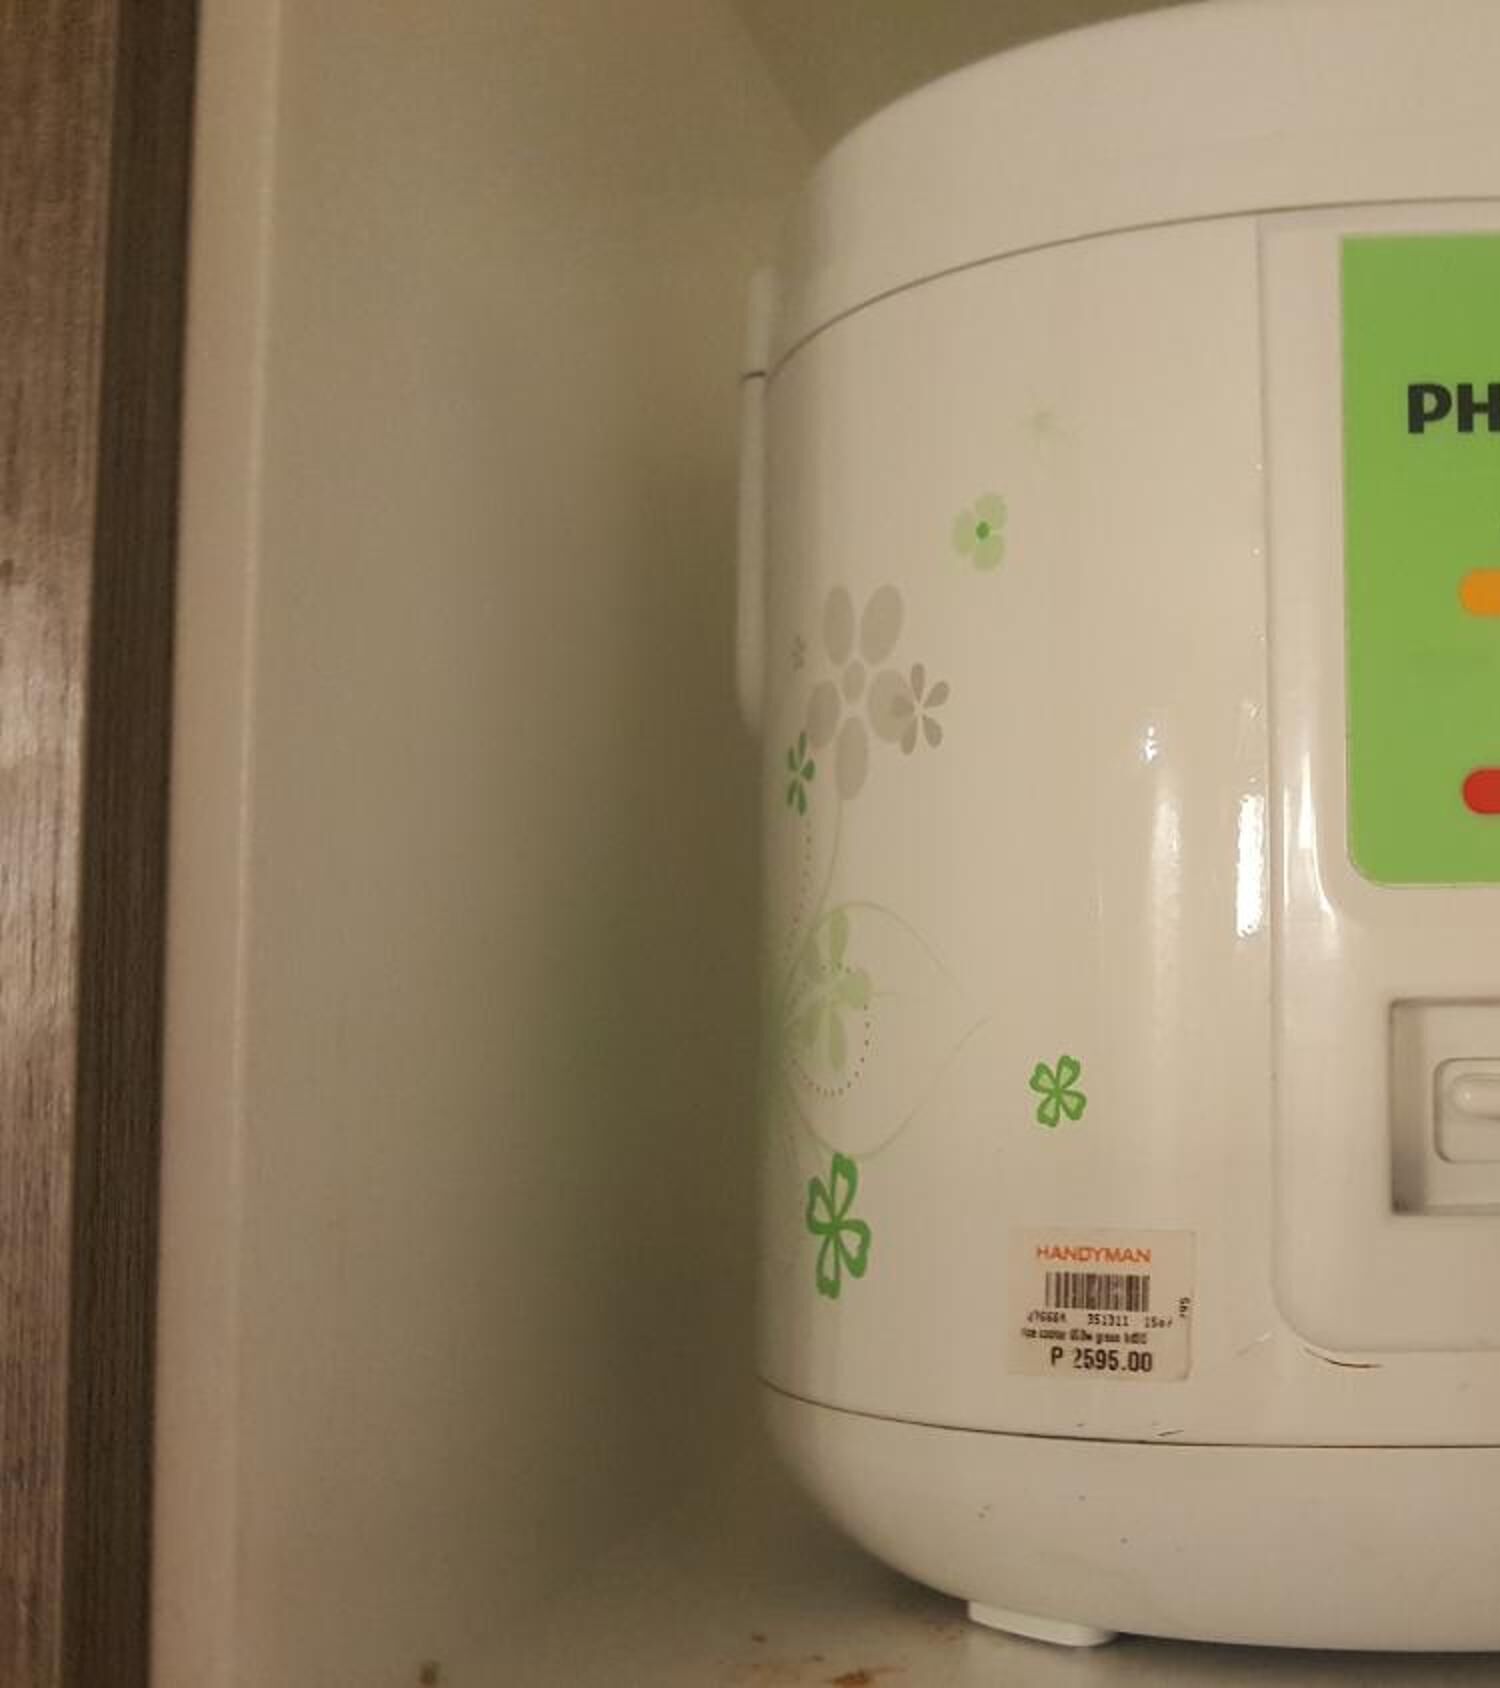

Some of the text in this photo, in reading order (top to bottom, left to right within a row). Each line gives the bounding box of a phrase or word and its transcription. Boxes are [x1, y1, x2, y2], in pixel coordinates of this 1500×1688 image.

[1036, 1246, 1152, 1262] HANDYMAN
[1051, 1346, 1153, 1373] P 2595.00
